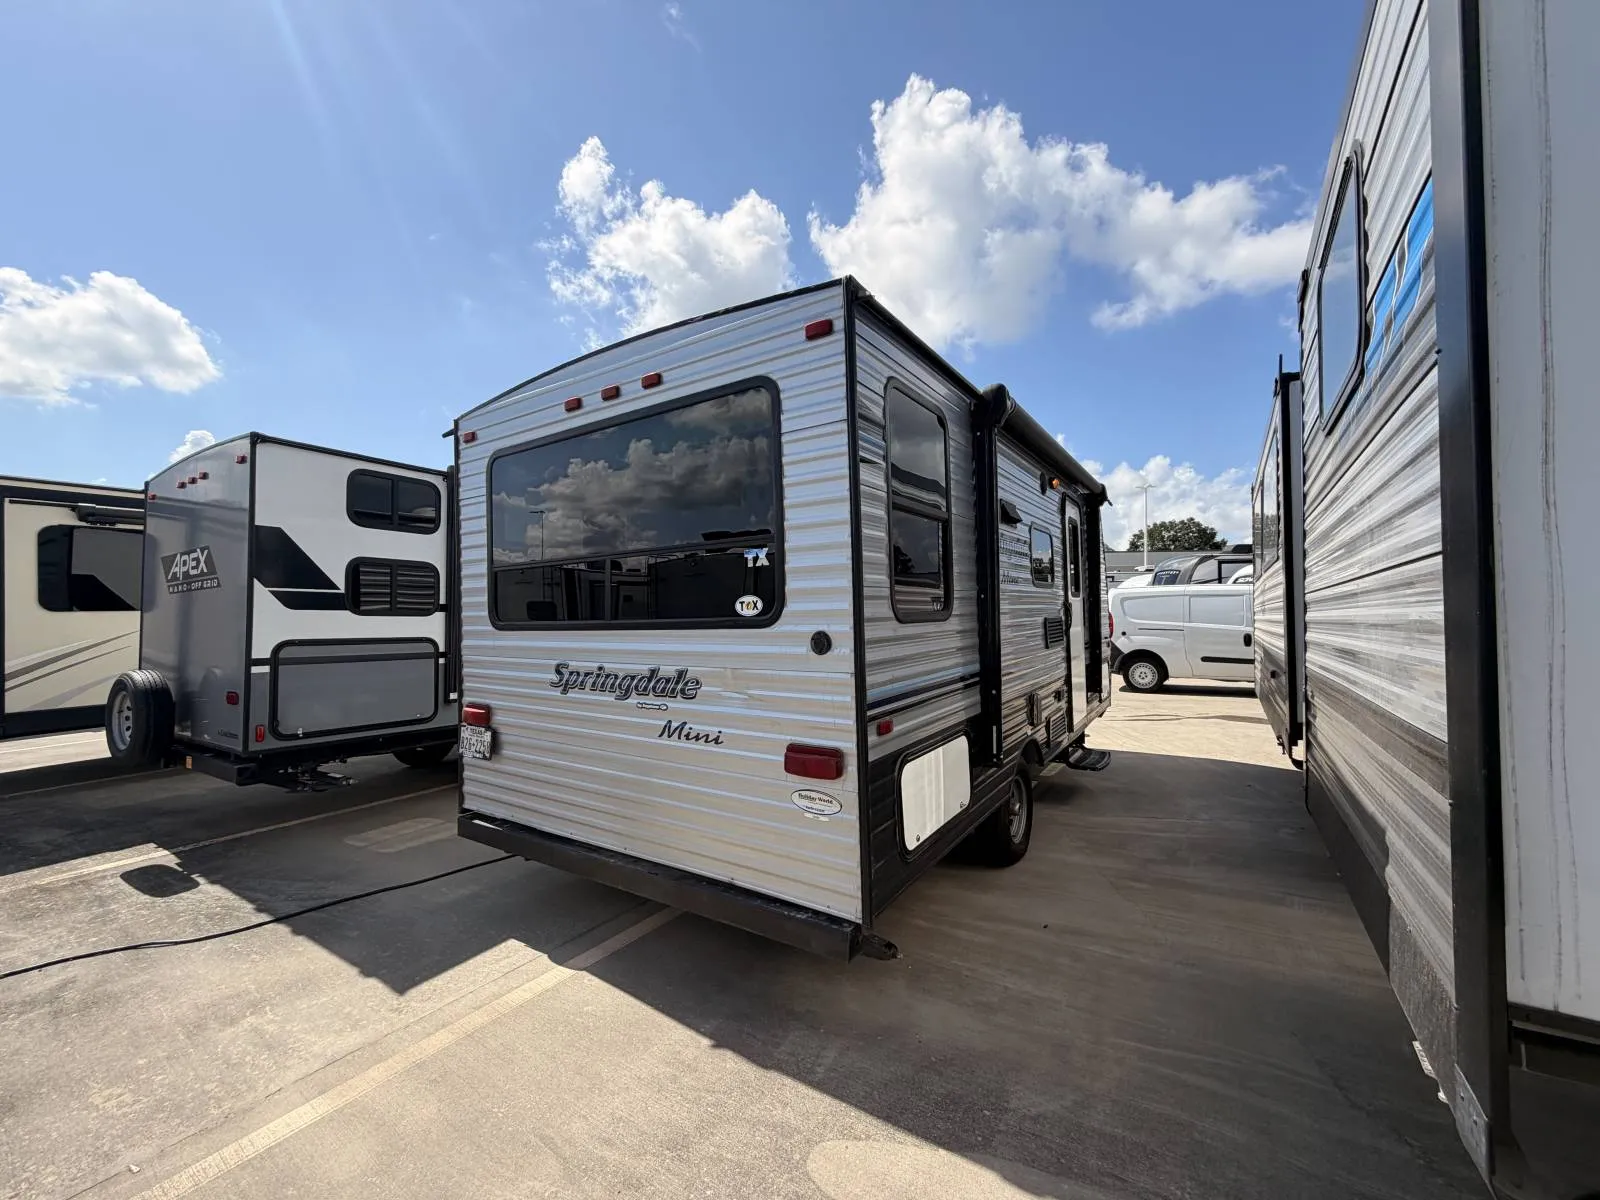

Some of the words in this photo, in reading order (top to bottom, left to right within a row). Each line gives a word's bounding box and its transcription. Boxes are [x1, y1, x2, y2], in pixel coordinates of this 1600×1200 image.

[167, 548, 208, 580] APEX
[743, 547, 770, 568] TX
[549, 661, 703, 701] Springdale
[658, 719, 724, 745] Mini
